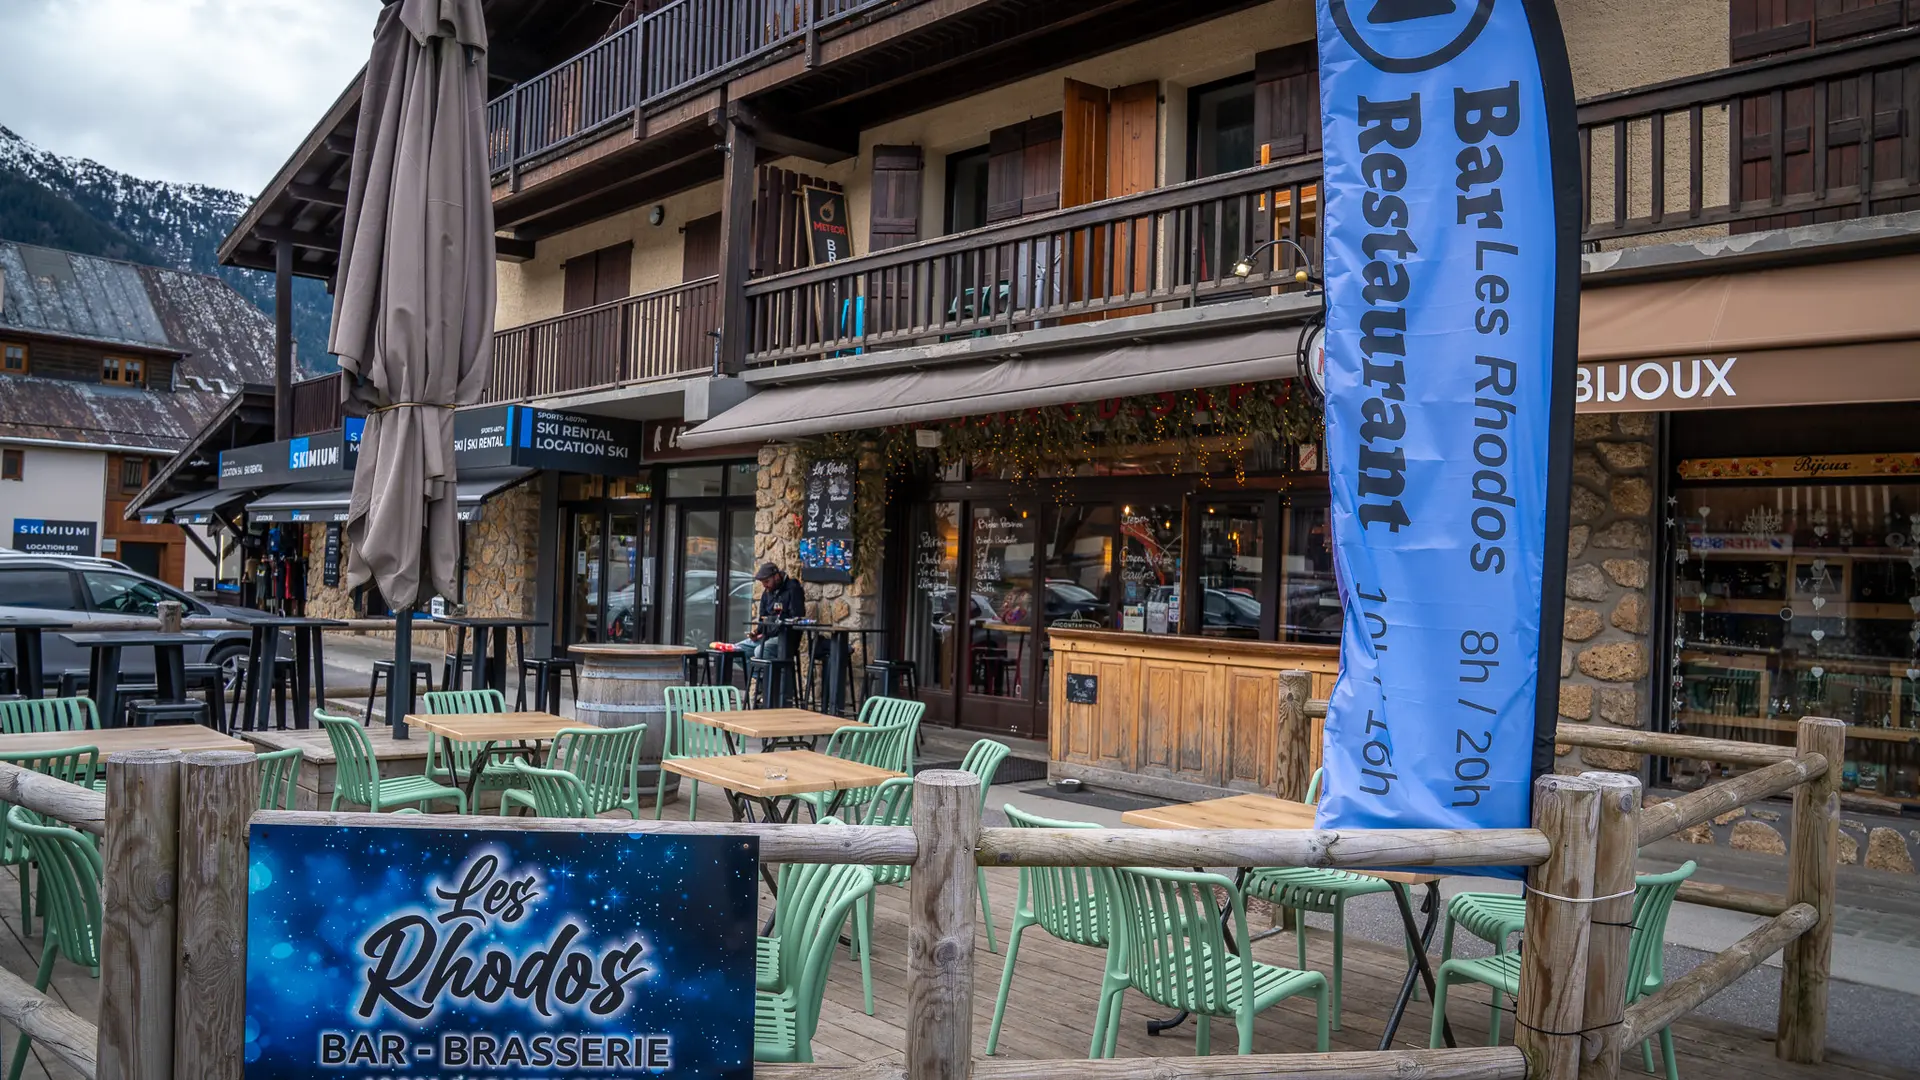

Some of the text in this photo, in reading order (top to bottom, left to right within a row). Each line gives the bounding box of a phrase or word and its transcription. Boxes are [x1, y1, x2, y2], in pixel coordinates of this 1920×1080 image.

[1453, 80, 1520, 229] Bar
[1474, 240, 1518, 336] Les
[1356, 92, 1423, 533] Restaurant
[1576, 357, 1738, 403] BIJOUX
[536, 422, 614, 442] SKI RENTAL
[537, 412, 588, 424] SPORTS 4807m
[293, 447, 337, 469] SKIMIUM
[467, 438, 478, 450] SKI
[478, 436, 504, 449] RENTAL
[536, 438, 629, 459] LOCATION SKI
[1469, 355, 1518, 576] Rhodos
[1793, 456, 1851, 476] Bijoux
[20, 524, 86, 536] SKIMIUM
[26, 543, 64, 551] LOCATION
[1459, 630, 1499, 683] 8h
[1452, 728, 1492, 807] 20h
[436, 854, 540, 926] Les
[358, 914, 650, 1020] Rhodos
[320, 1034, 407, 1065] BAR
[443, 1036, 671, 1068] BRASSERIE
